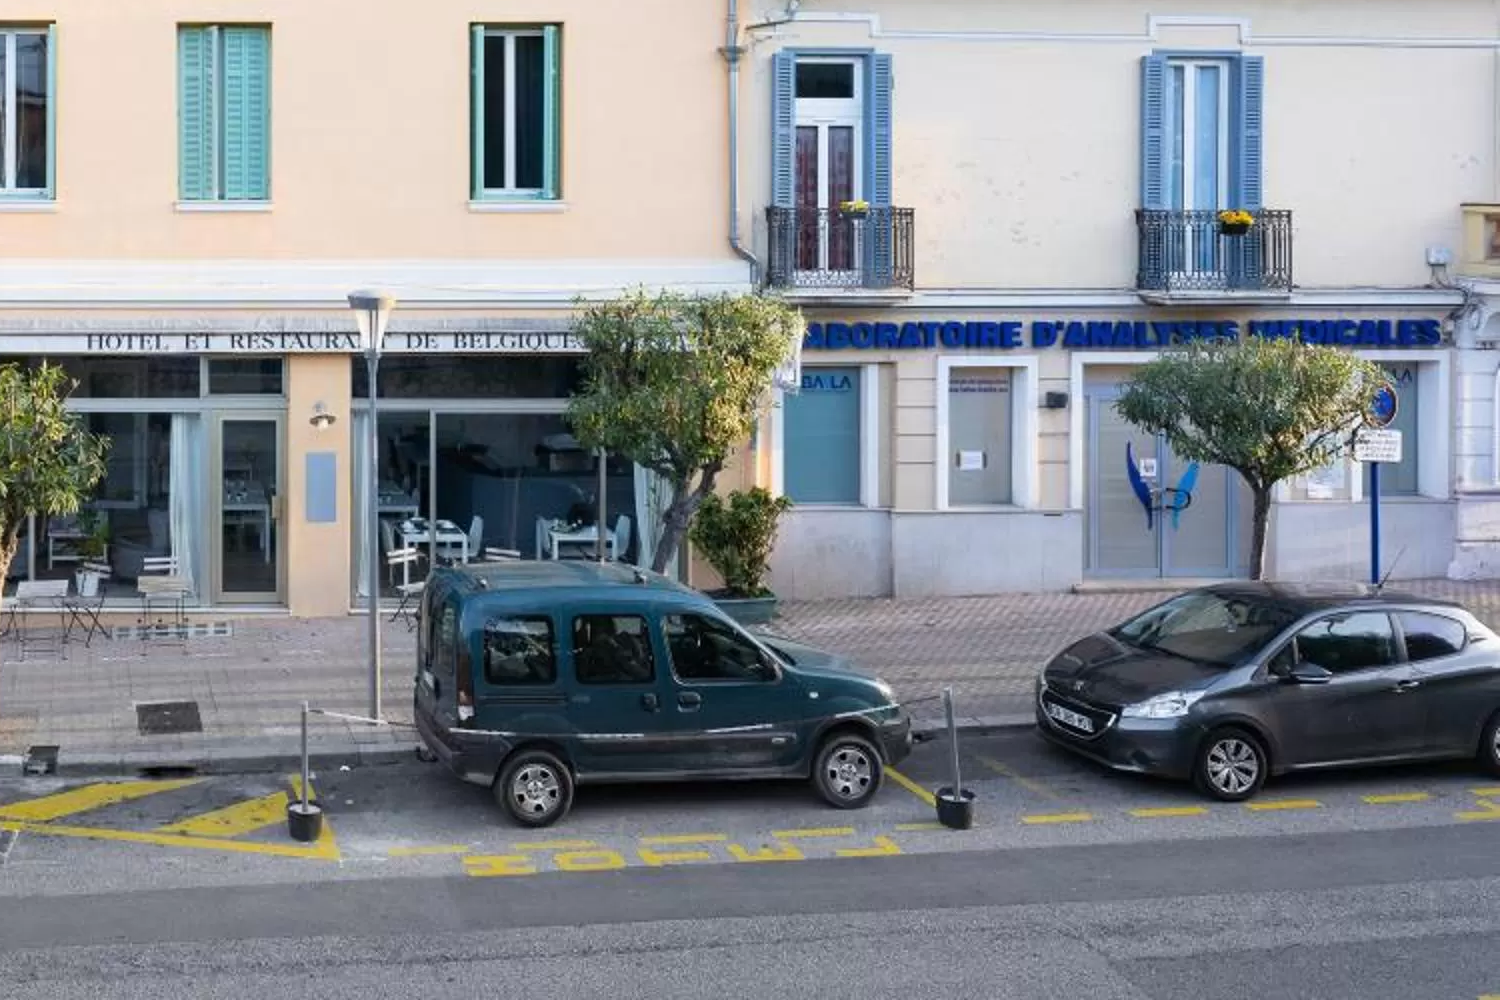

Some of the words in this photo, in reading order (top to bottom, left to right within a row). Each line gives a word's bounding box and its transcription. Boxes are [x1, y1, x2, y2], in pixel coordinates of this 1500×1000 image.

[86, 332, 169, 350] HOTEL
[185, 331, 212, 350] ET
[231, 331, 393, 350] RESTAURAT
[405, 331, 439, 349] DE
[453, 331, 584, 351] BELGIQUE
[802, 321, 1023, 349] ABORATOIRE
